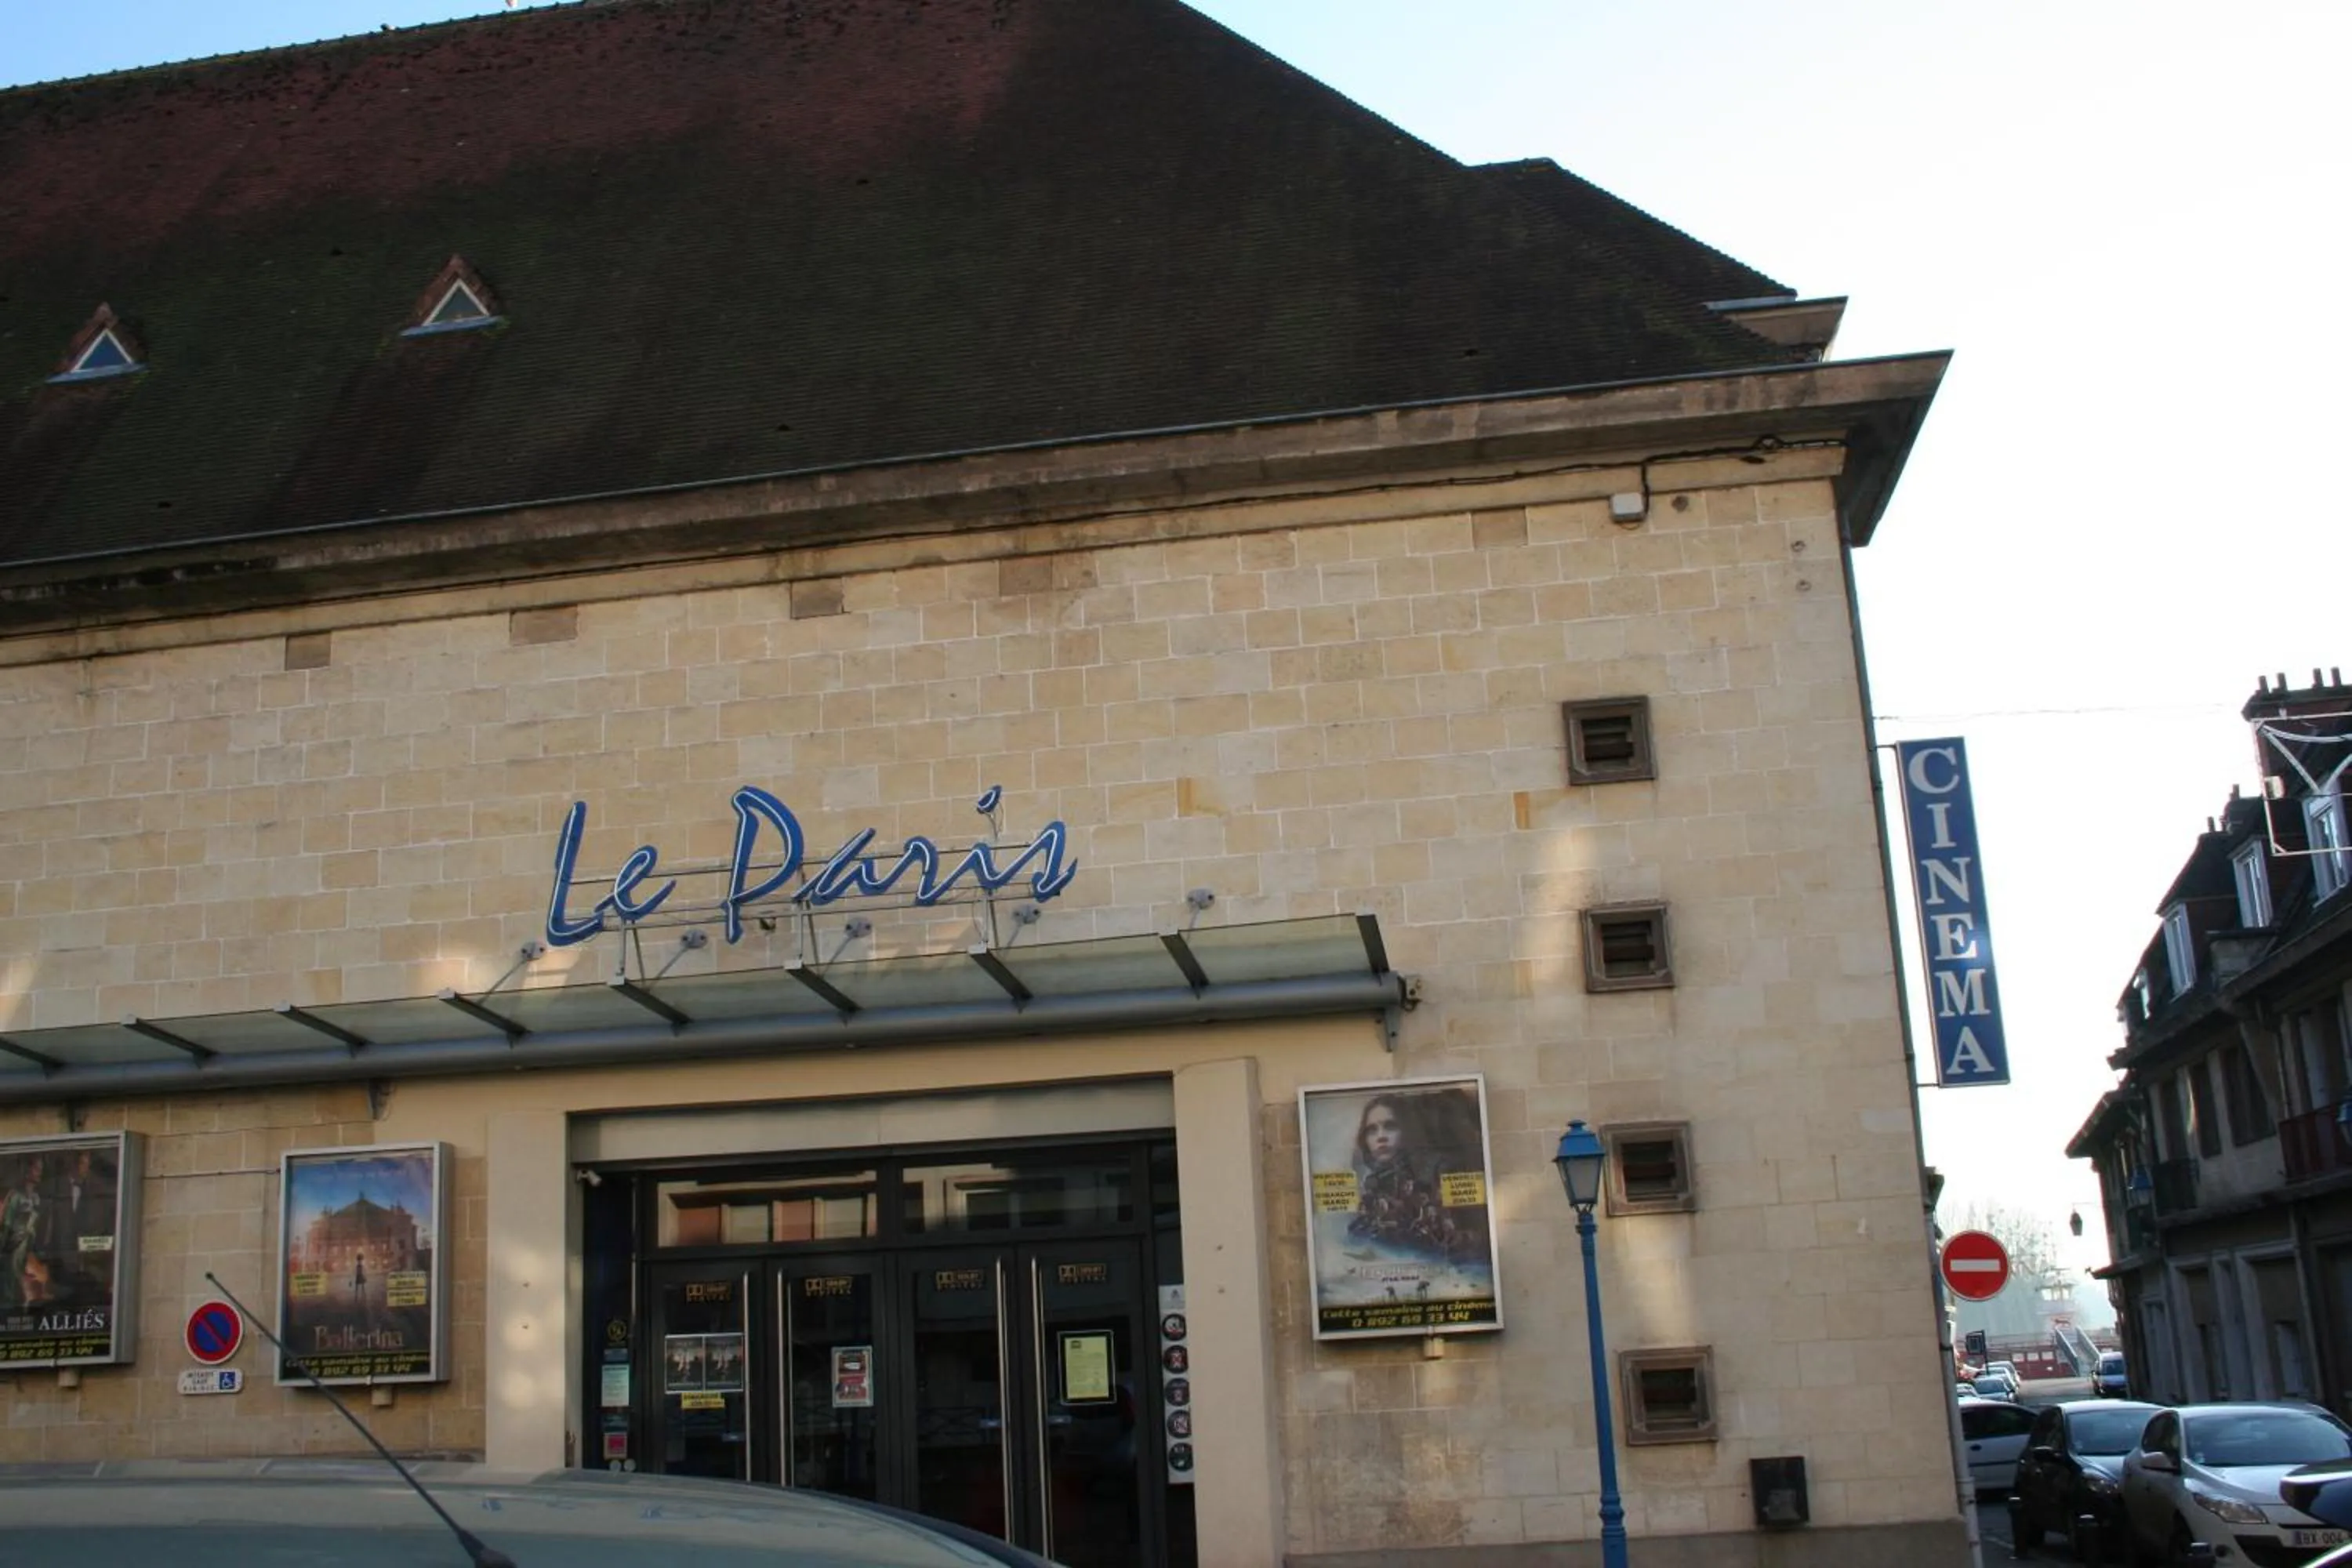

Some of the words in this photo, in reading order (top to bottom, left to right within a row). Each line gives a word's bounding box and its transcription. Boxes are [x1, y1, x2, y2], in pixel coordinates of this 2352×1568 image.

[546, 800, 676, 946] Le
[721, 785, 1079, 944] Paris
[1907, 746, 1995, 1075] CINEMA
[38, 1308, 104, 1330] ALLIÉS
